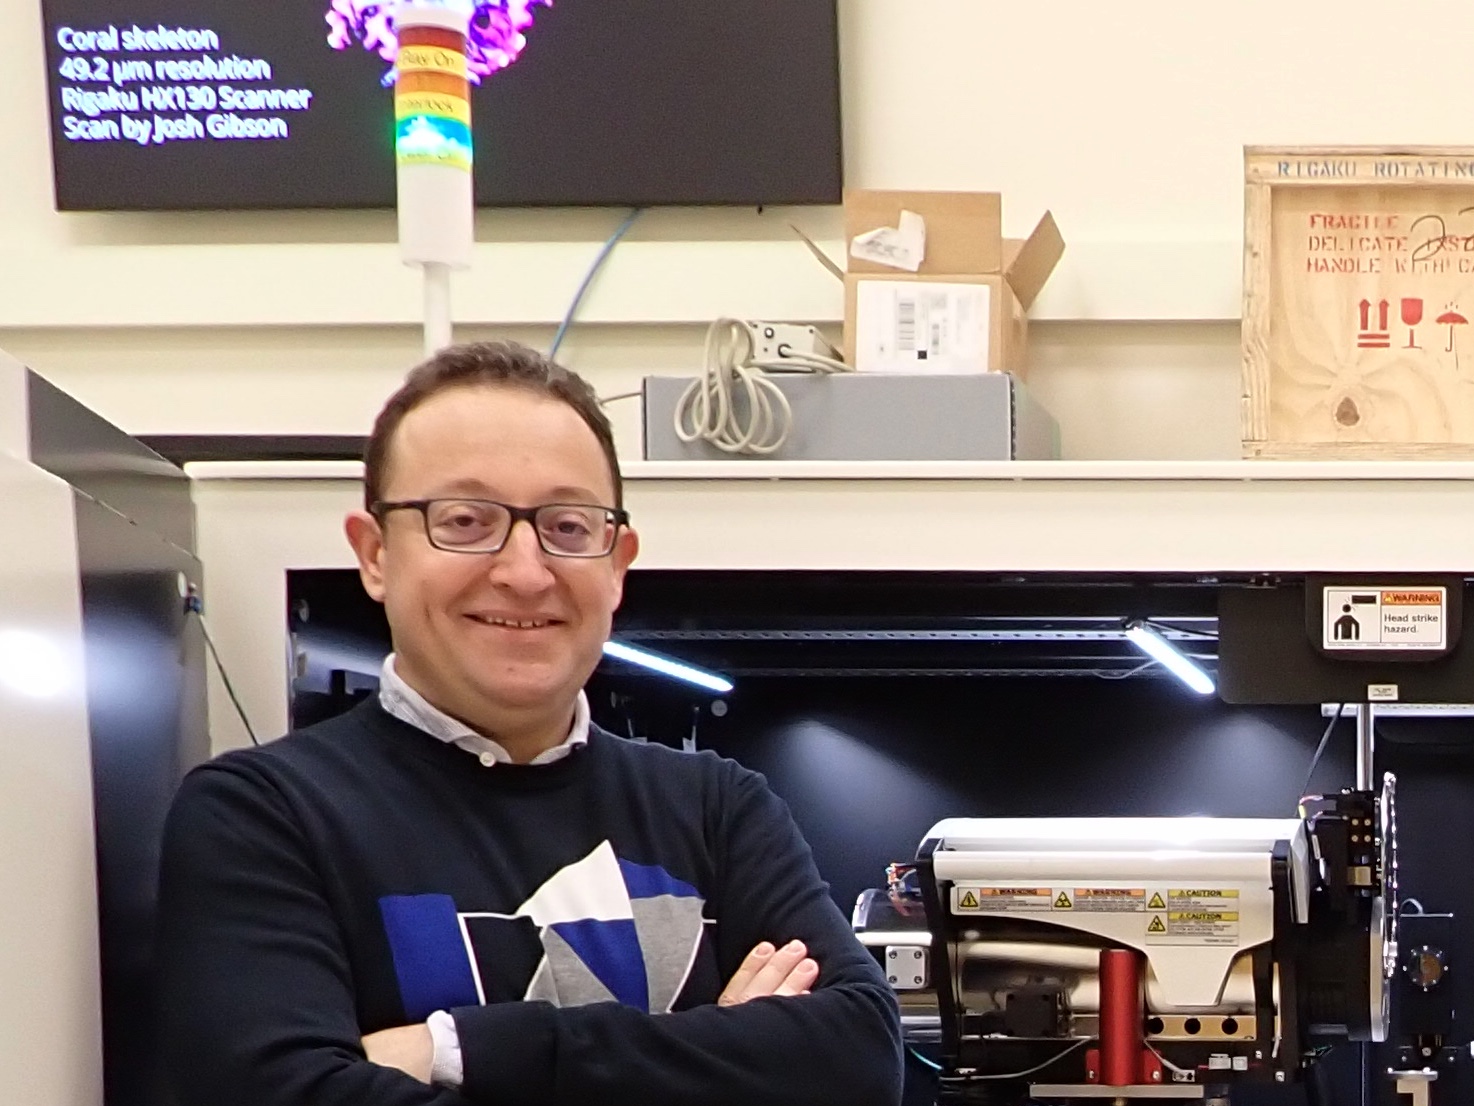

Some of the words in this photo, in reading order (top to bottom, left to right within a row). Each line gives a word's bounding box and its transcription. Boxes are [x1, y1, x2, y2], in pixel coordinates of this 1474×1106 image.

[57, 24, 119, 51] Coral
[121, 24, 219, 51] skeleton
[59, 56, 110, 81] 49.2
[155, 54, 272, 81] resolution
[61, 85, 139, 117] Rigaku
[141, 86, 216, 111] HX130
[218, 86, 312, 111] Scanner
[63, 115, 120, 140] Scan
[121, 114, 151, 145] by
[152, 113, 205, 145] Josh
[206, 112, 288, 139] Gibson
[1277, 161, 1357, 177] RIGAKU
[1309, 214, 1400, 230] FRAGILE
[1308, 235, 1408, 252] DELICATE
[1306, 257, 1381, 273] HANDLE
[1394, 258, 1446, 274] WITH
[1393, 593, 1440, 603] WARNING
[1384, 613, 1409, 623] Head
[1411, 613, 1439, 623] strike
[1186, 889, 1222, 897] CAUTION
[1186, 912, 1222, 920] CAUTION
